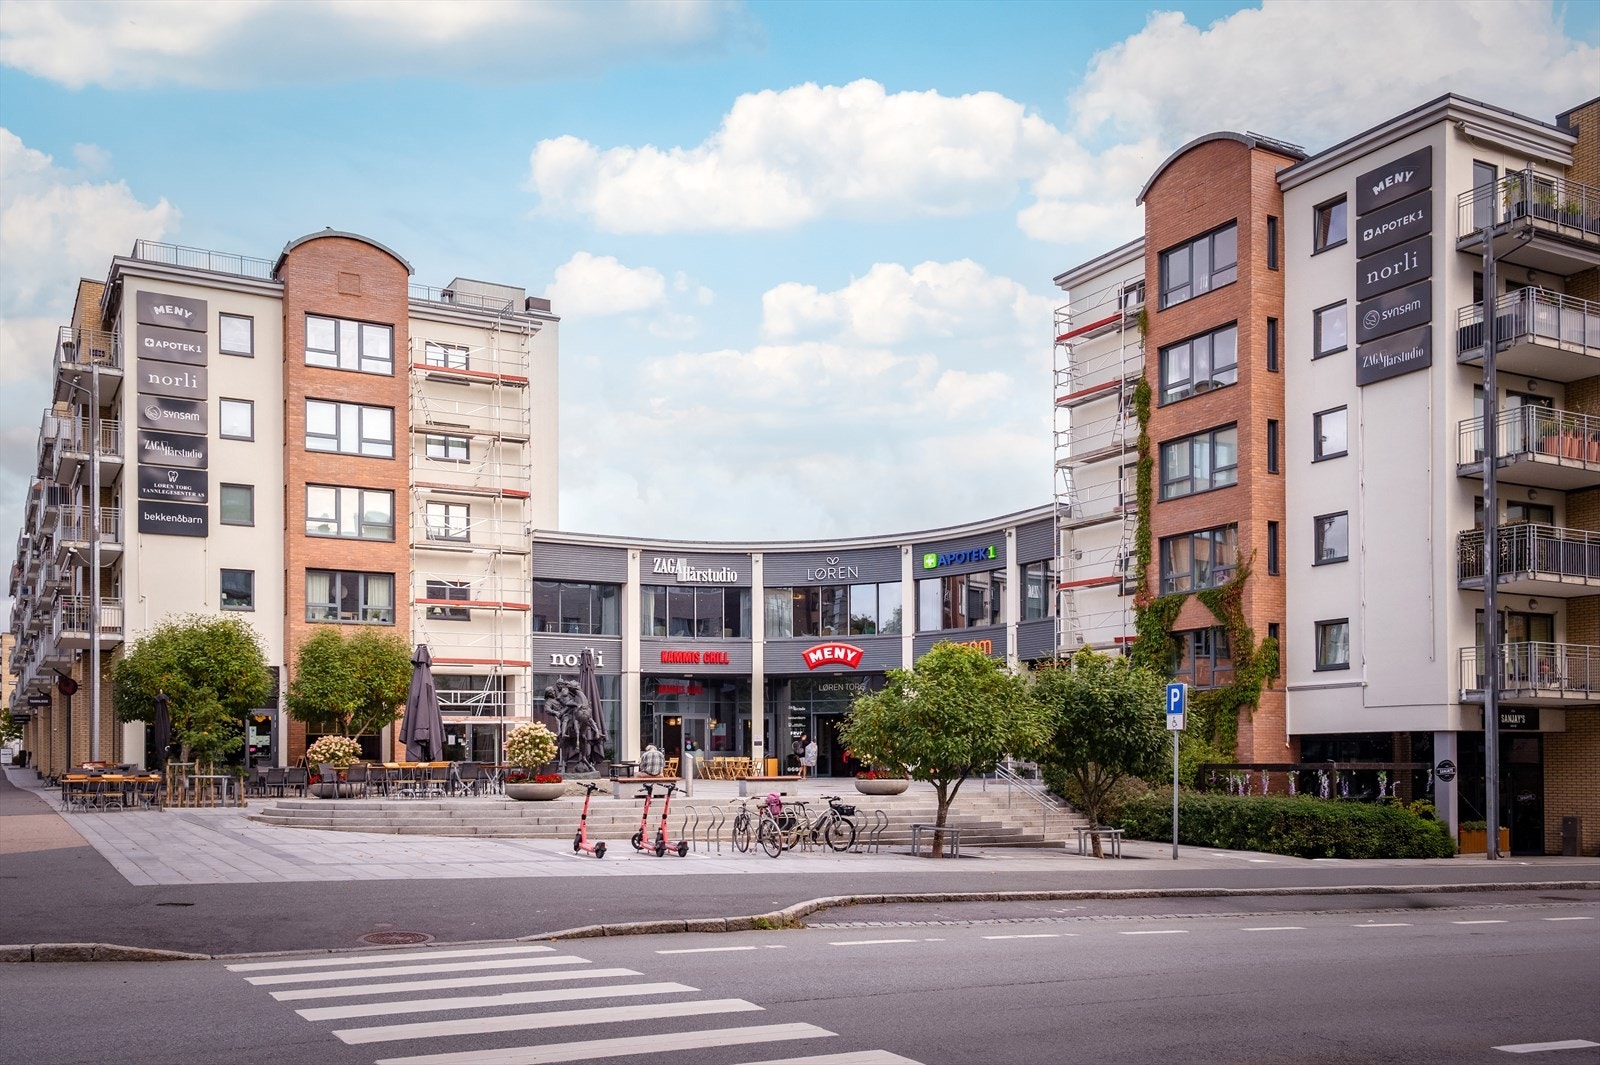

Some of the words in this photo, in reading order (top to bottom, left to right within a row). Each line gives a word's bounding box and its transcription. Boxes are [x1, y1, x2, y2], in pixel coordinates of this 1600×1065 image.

[1372, 170, 1414, 196] MENY
[1374, 212, 1416, 237] APOTEK
[1366, 251, 1418, 284] norli
[153, 305, 193, 320] MENY
[155, 340, 195, 352] APOTEK
[148, 372, 198, 388] norli
[142, 488, 197, 497] TANNLEGESENTER
[937, 548, 988, 567] APOTEK
[653, 557, 683, 574] ZAGA
[683, 565, 738, 583] Hårstudio
[807, 566, 859, 582] LØREN
[550, 647, 604, 667] noi
[703, 651, 730, 665] GRILL
[809, 646, 858, 663] MENY
[818, 683, 844, 692] LØREN
[1171, 688, 1180, 711] P
